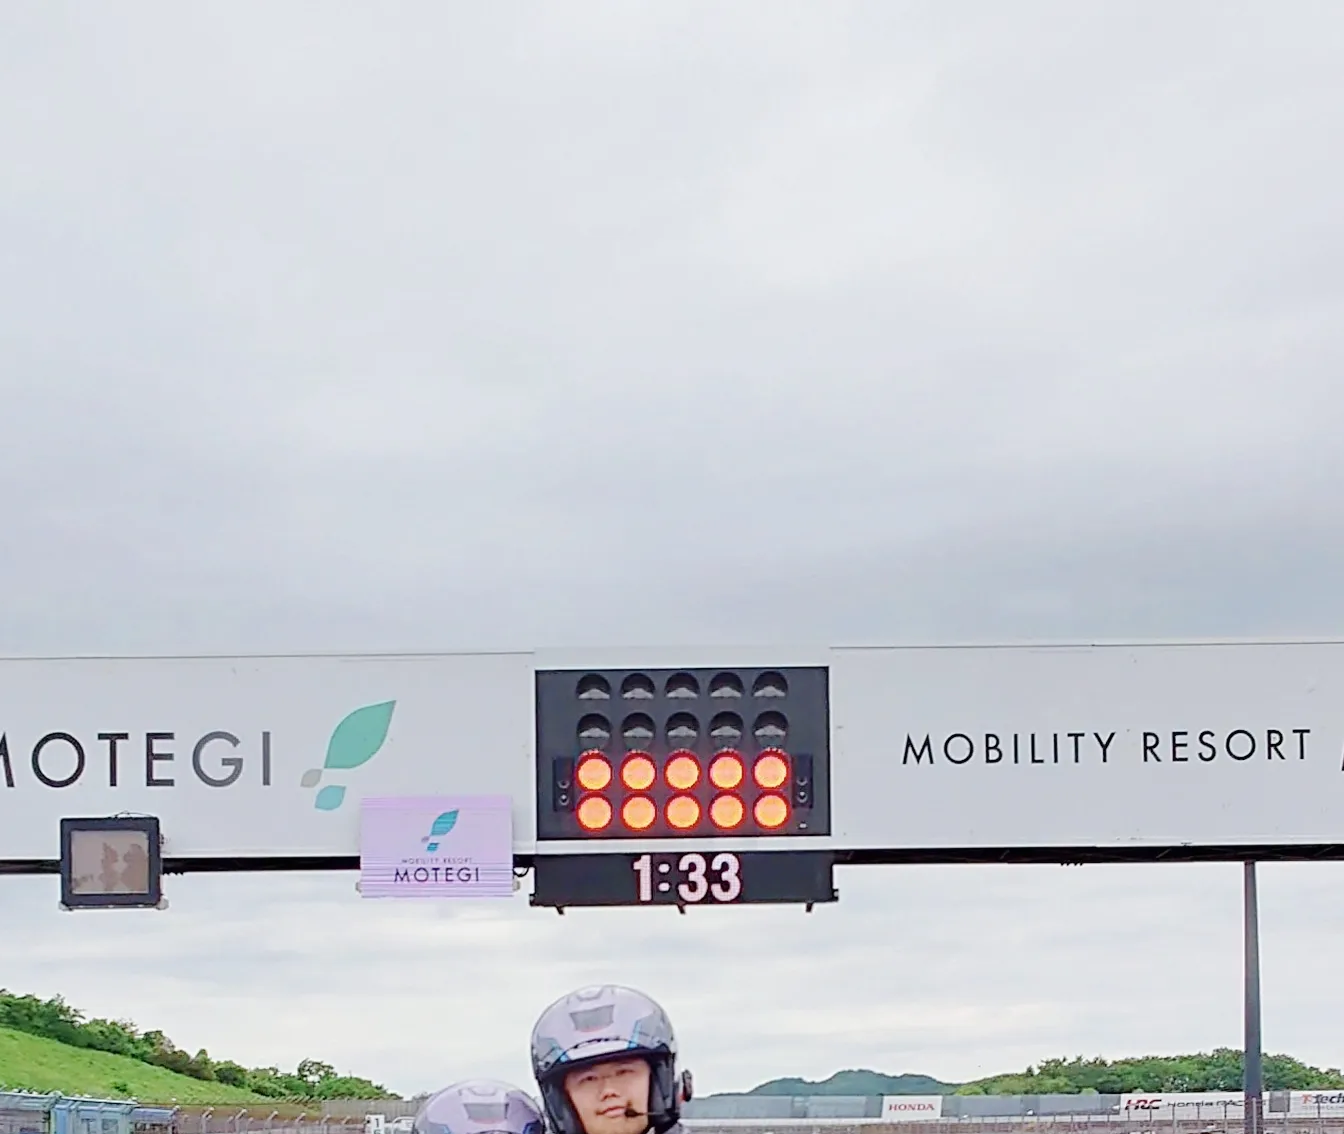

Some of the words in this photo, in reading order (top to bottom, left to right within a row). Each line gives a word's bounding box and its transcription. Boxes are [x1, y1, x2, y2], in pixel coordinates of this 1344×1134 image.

[902, 732, 1116, 765] MOBILITY
[1143, 729, 1311, 762] RESORT
[394, 867, 479, 883] MOTEGI
[632, 853, 742, 901] 1:33
[889, 1103, 935, 1111] HONDA
[1125, 1099, 1162, 1110] HRC
